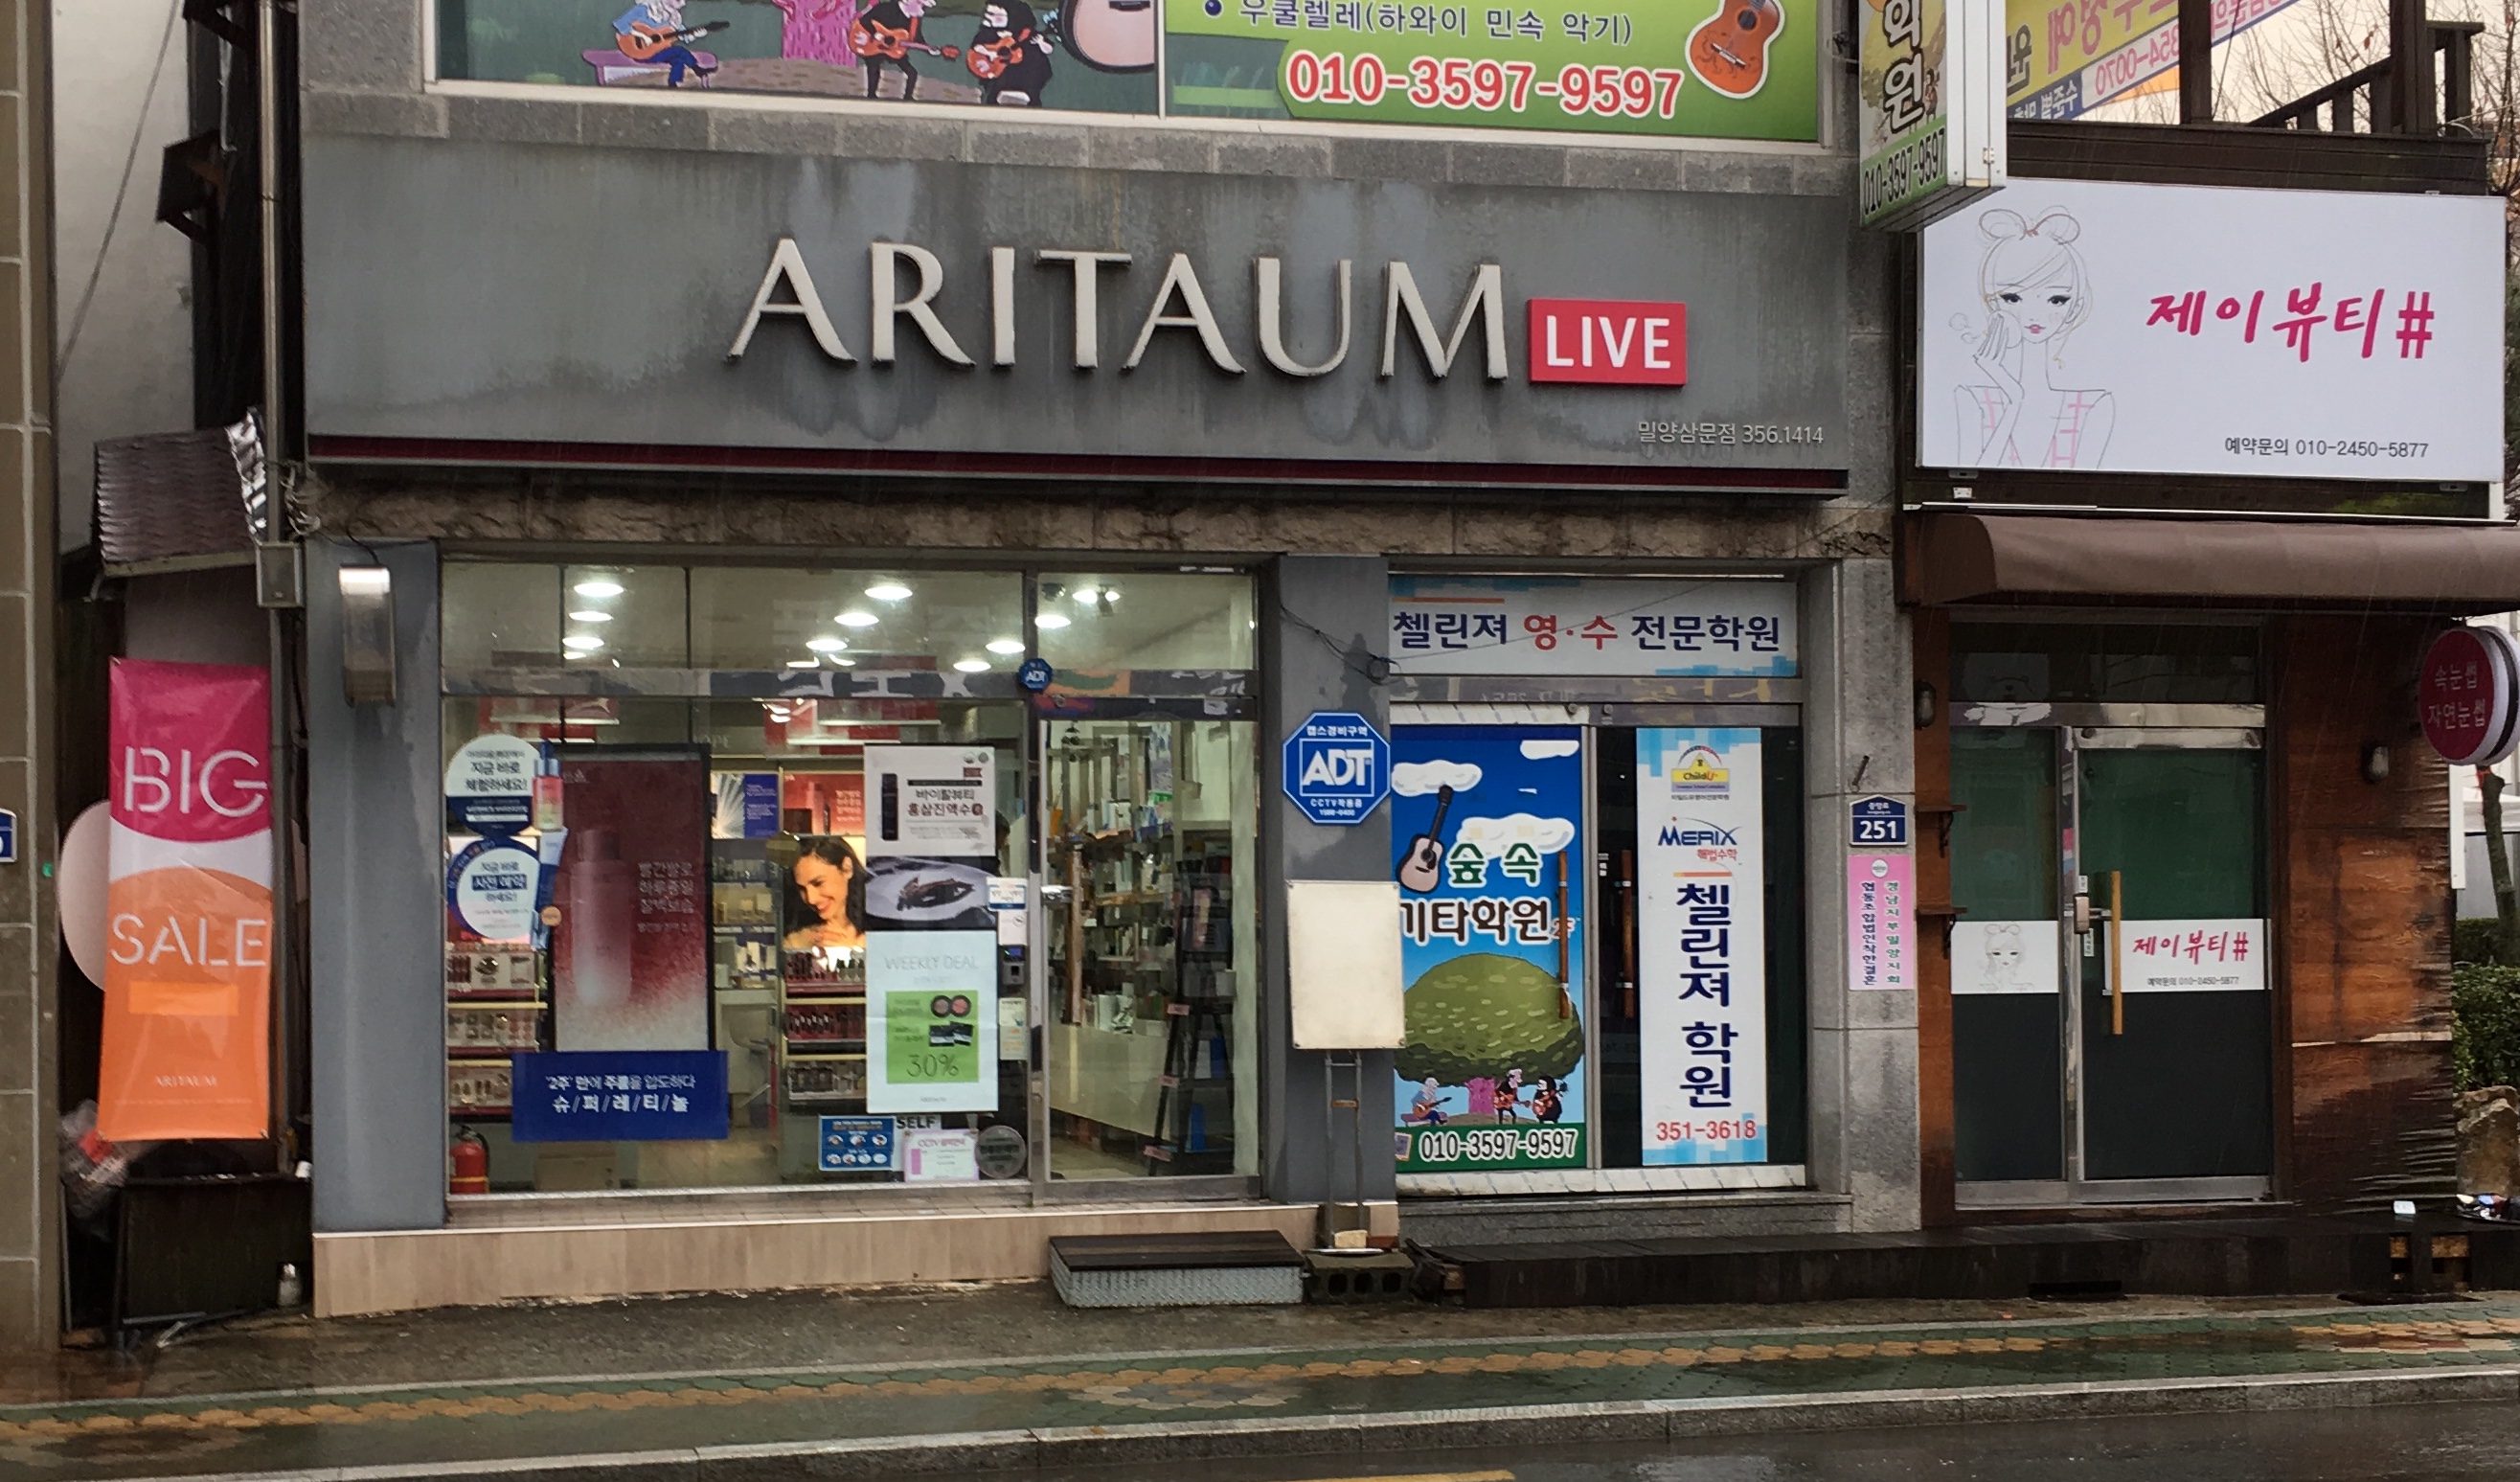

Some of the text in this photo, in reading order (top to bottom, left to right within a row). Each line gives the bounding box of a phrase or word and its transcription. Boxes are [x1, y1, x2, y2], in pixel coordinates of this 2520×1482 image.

[1239, 0, 1632, 46] 우쿨렐레(하와이 민속 악기)
[1287, 51, 1685, 120] 010-3597-9597
[1882, 0, 1925, 134] 학원
[1862, 126, 1946, 216] 010-3597-9597
[725, 238, 1672, 381] ARITAUM LIVE
[2146, 282, 2436, 363] 제이뷰티#
[1638, 421, 1824, 445] 밀양삼문점 356.1414
[2224, 437, 2430, 459] 예약문의 010-2450-5877
[1393, 611, 1508, 650] 첼린져
[1630, 615, 1781, 652] 전문학원
[124, 745, 268, 818] BIG
[1302, 748, 1373, 787] ADT
[1658, 825, 1738, 846] MERIX
[1859, 820, 1896, 839] 251
[1448, 843, 1539, 884] 숲 속
[110, 913, 268, 968] SALE
[2132, 929, 2249, 966] 제이뷰티#
[1676, 882, 1738, 1108] 첼린져 학원
[906, 1053, 960, 1078] 30%
[896, 1115, 938, 1129] SELF
[1655, 1121, 1758, 1142] 351-3618
[1419, 1129, 1578, 1162] 010-3597-9597
